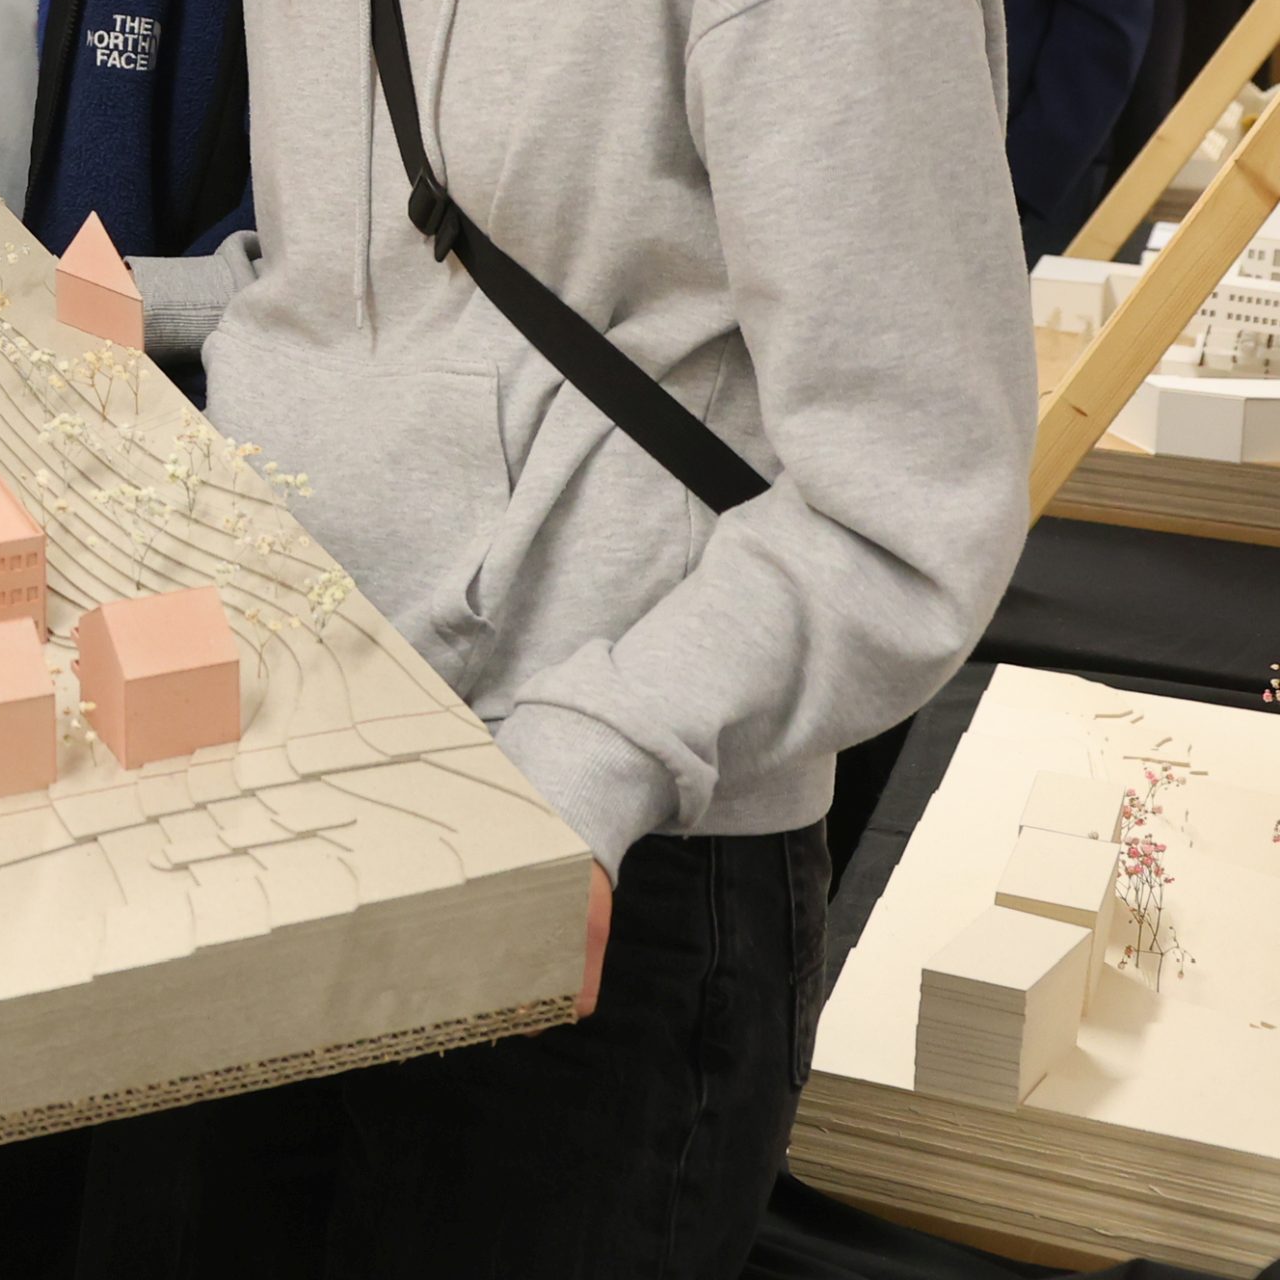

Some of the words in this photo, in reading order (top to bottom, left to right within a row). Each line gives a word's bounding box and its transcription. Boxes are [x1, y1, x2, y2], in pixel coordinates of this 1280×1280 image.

[113, 14, 153, 35] THE
[87, 29, 150, 52] NORTH
[96, 50, 148, 71] FACE
